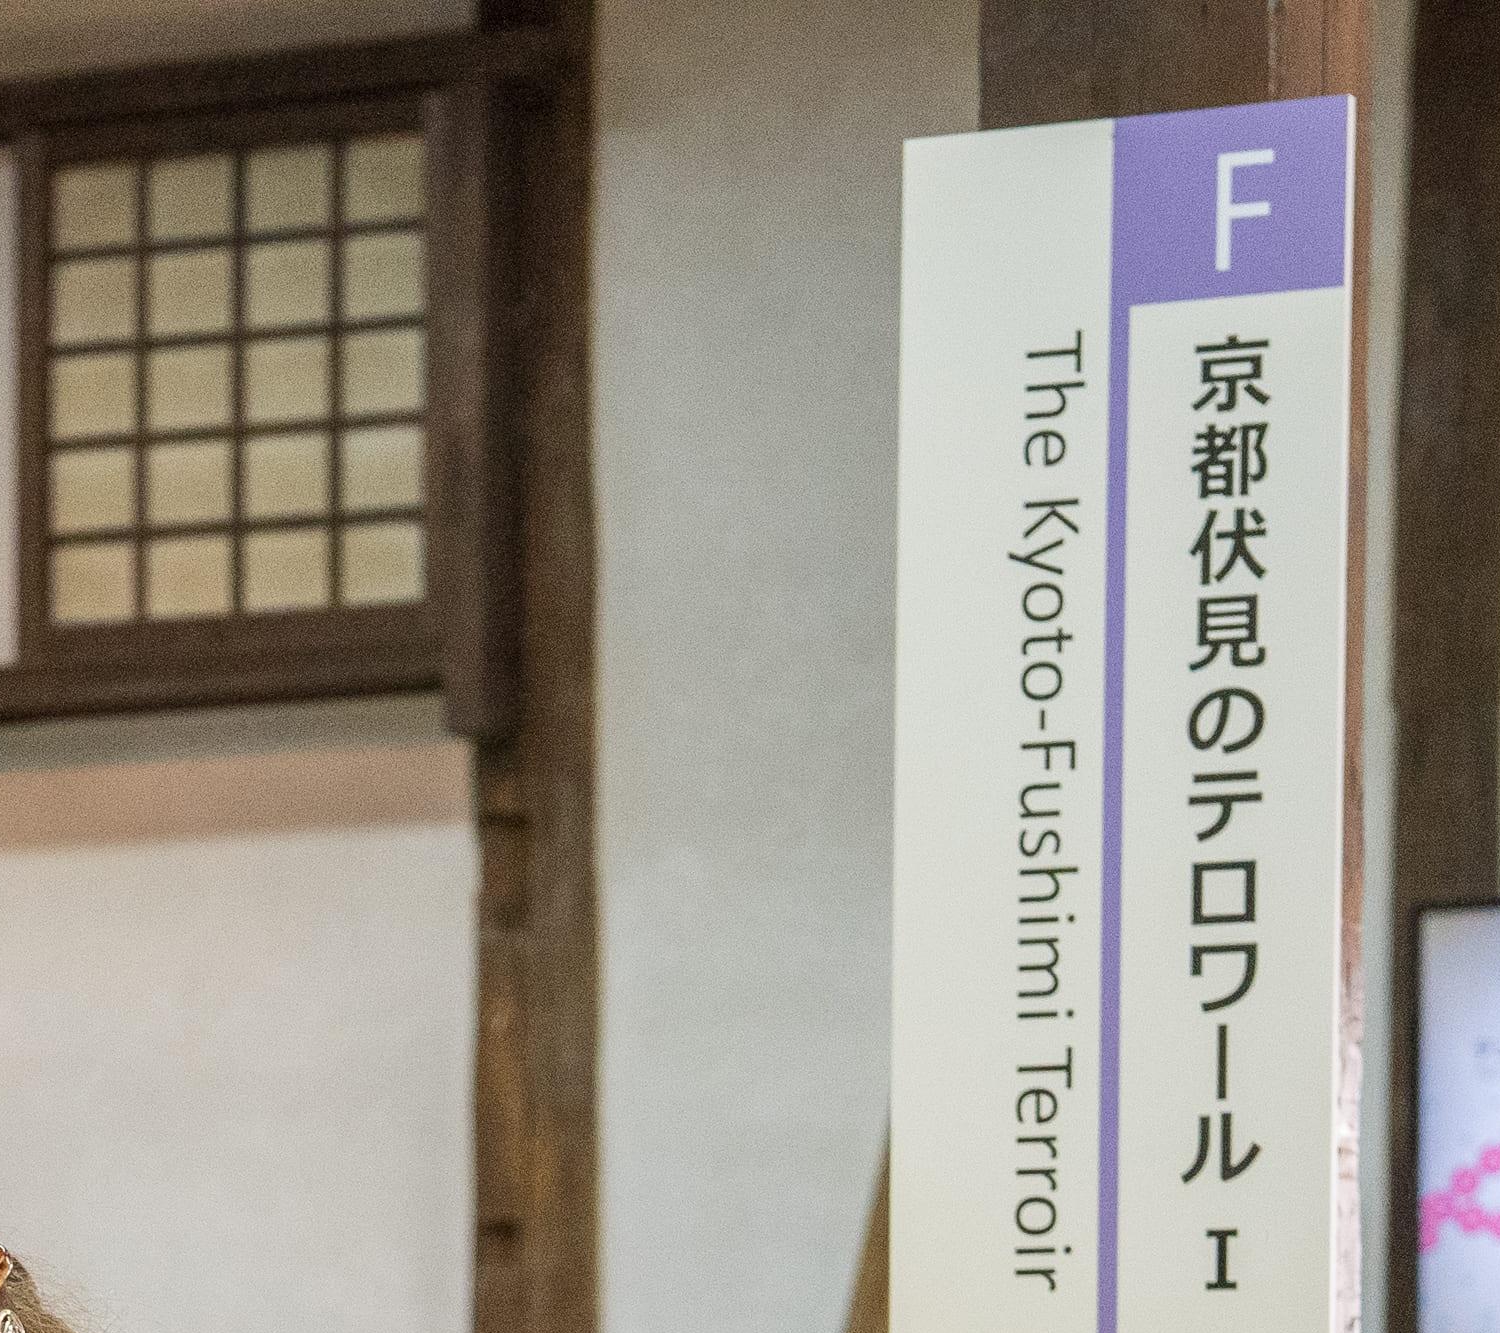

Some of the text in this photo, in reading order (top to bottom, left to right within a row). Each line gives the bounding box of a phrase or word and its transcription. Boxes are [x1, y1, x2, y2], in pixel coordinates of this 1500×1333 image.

[1214, 148, 1275, 272] F
[1024, 330, 1086, 467] The
[1007, 497, 1080, 1021] Kyoto-Fushimi
[1182, 335, 1271, 1184] 京都伏見のテロワール
[1014, 1047, 1074, 1292] Terroir
